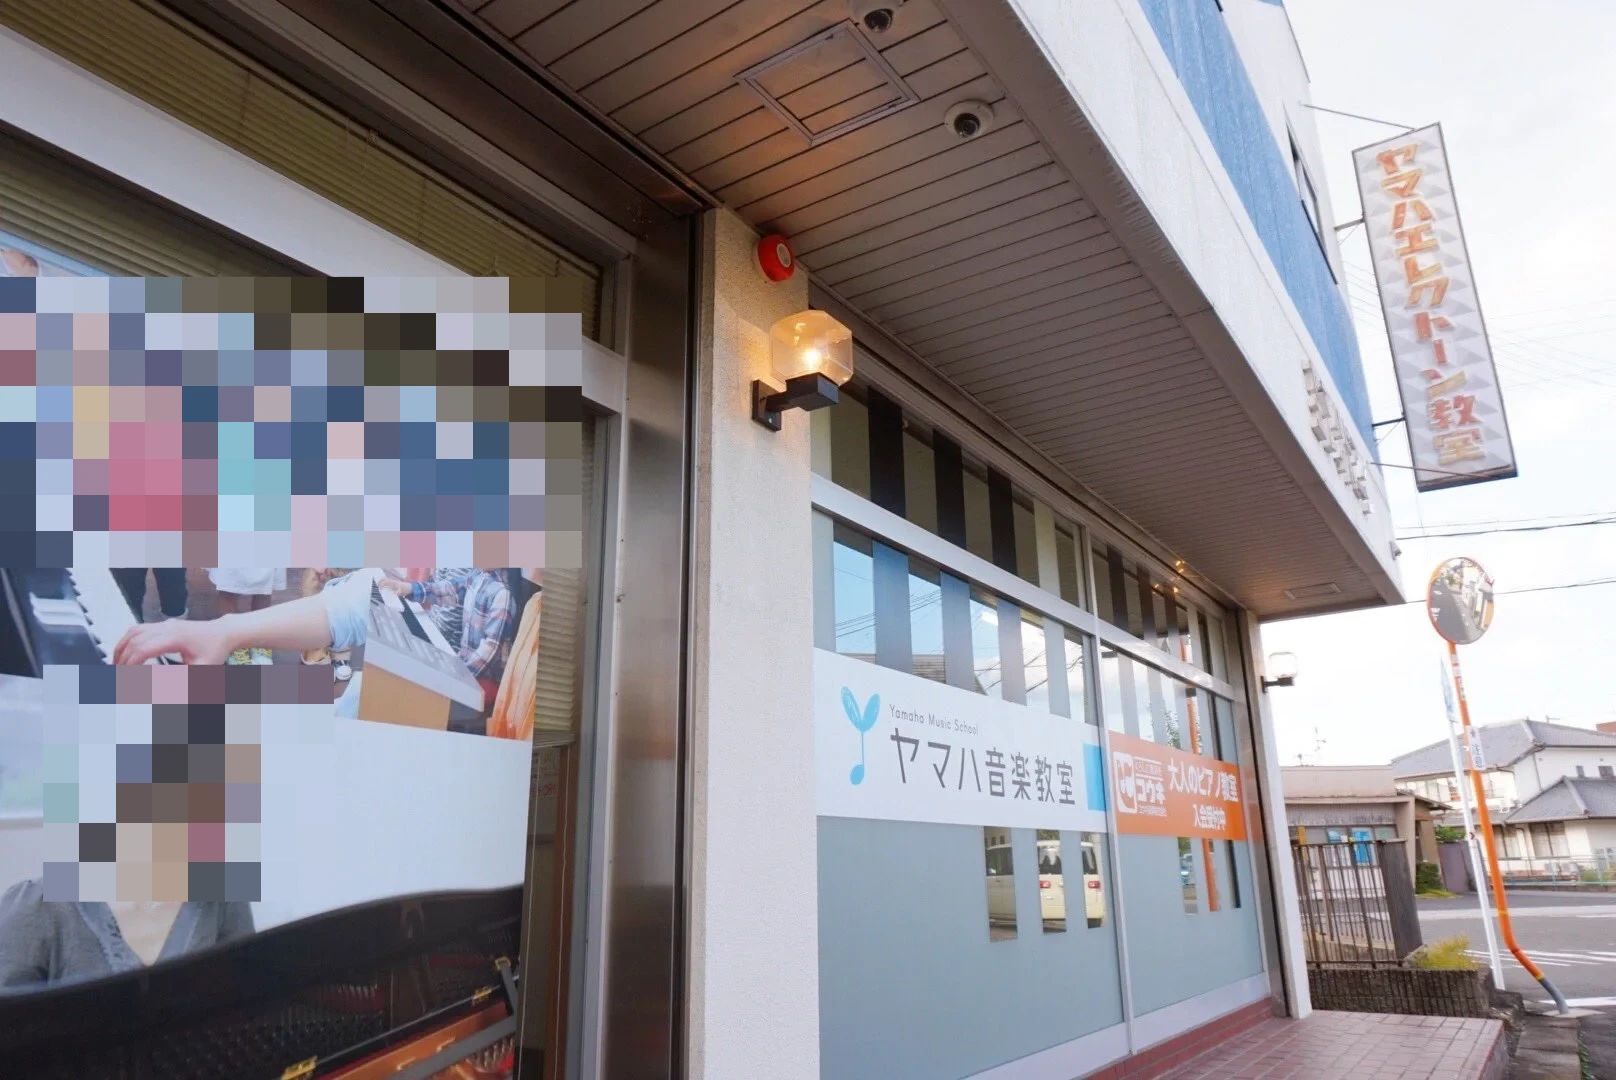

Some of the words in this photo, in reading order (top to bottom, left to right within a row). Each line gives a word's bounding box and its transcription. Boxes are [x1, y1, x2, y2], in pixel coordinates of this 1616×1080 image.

[1376, 143, 1486, 467] ヤマハエレクトーン教室
[889, 704, 925, 724] Yamaha
[928, 713, 952, 730] Music
[954, 719, 979, 736] School
[890, 727, 1075, 805] ヤマハ音楽教室
[1167, 757, 1239, 802] 大人のピアノ教室
